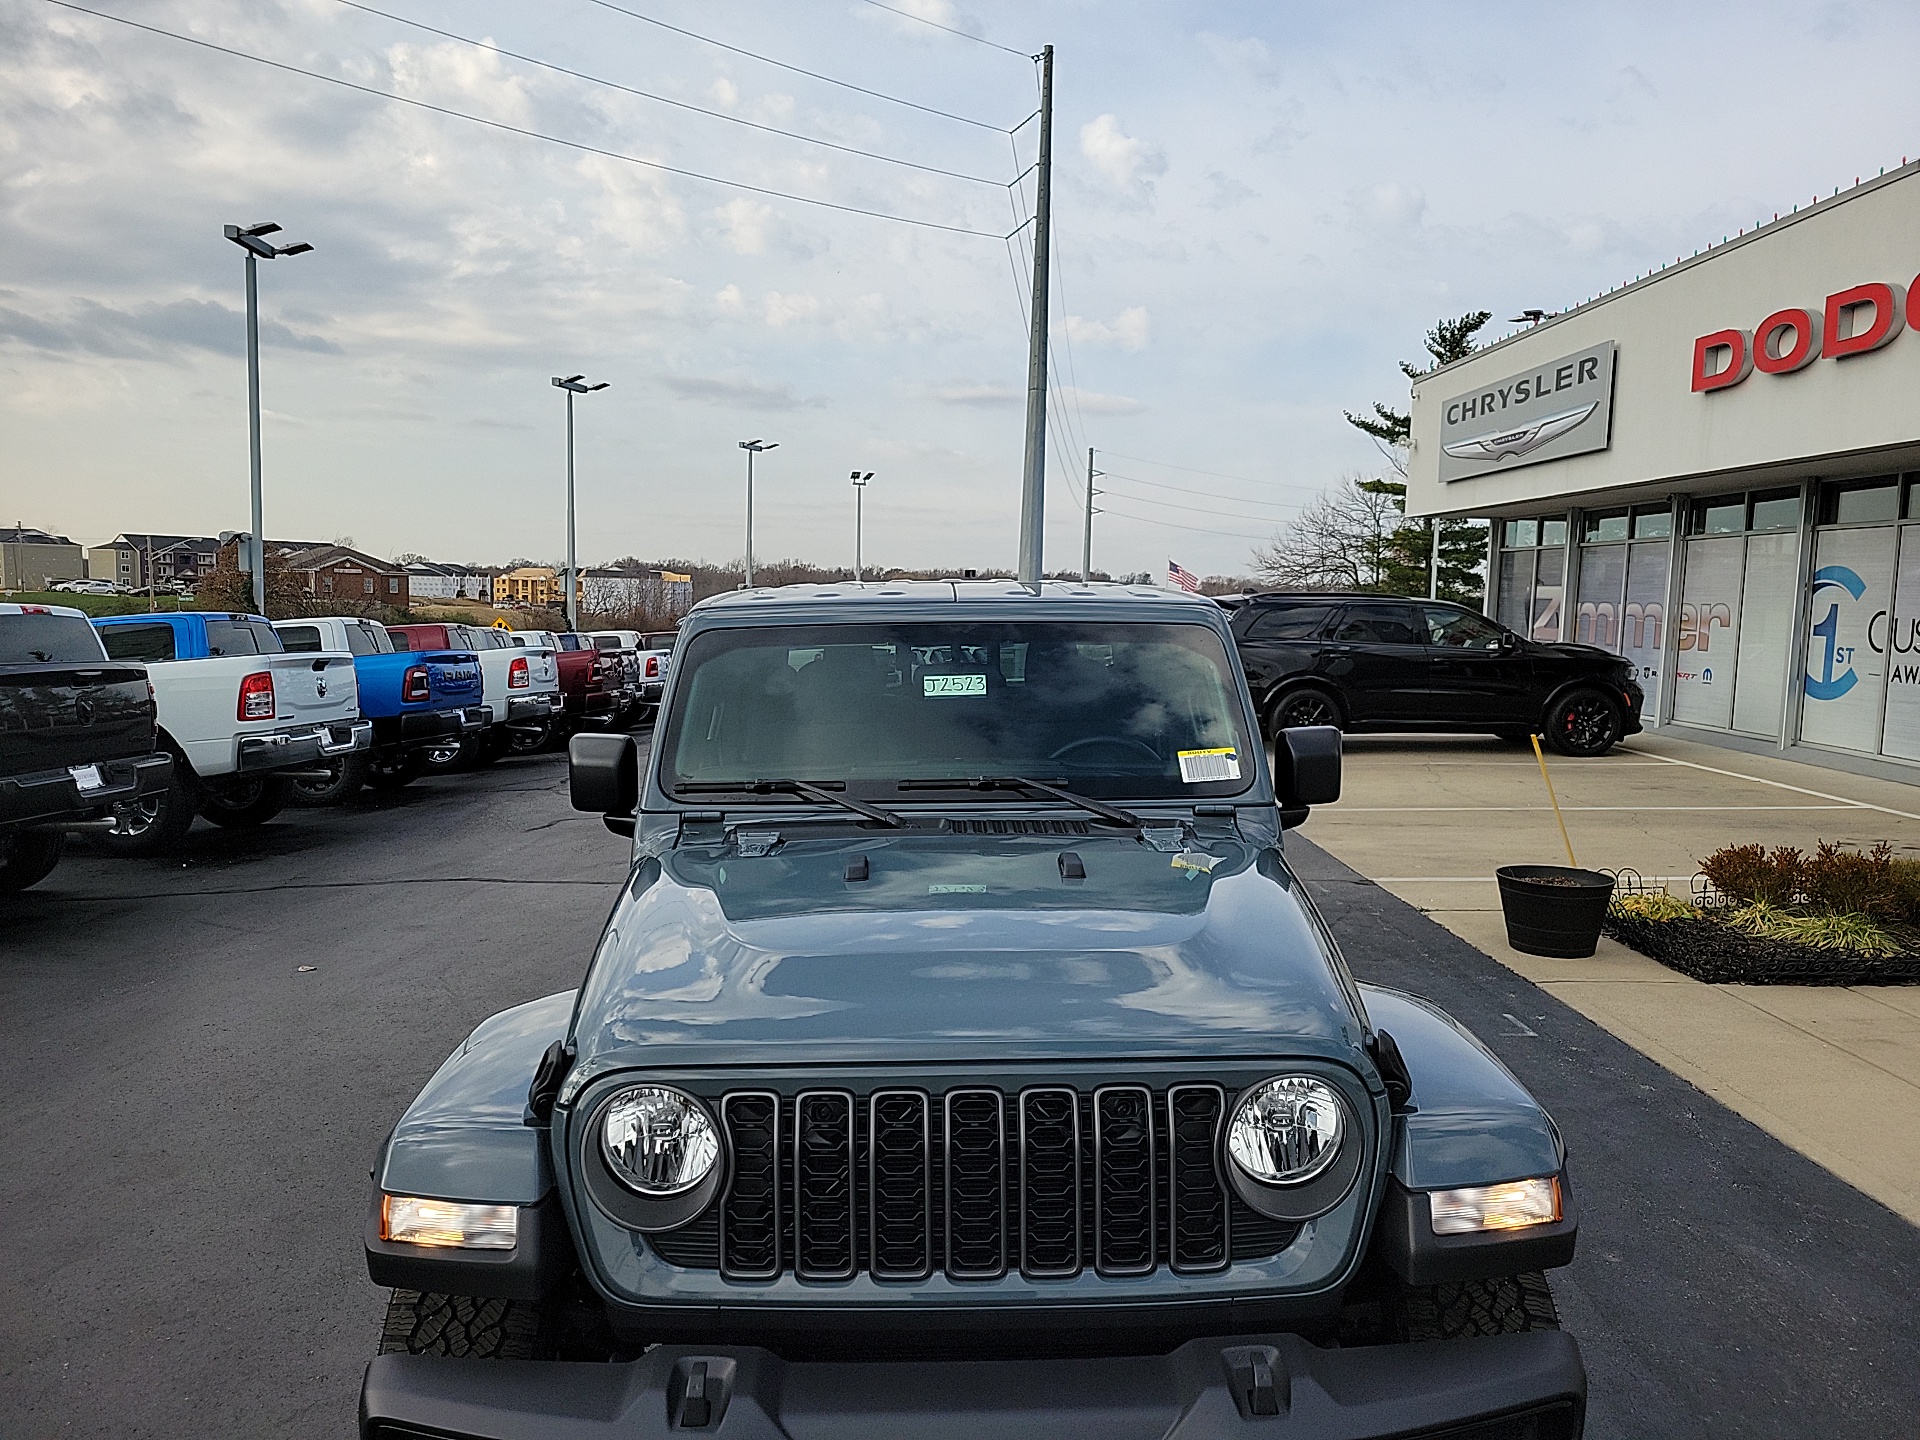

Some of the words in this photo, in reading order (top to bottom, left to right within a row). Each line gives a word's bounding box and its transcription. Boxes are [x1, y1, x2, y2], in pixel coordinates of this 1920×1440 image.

[1690, 271, 1920, 393] DOD
[1446, 356, 1598, 426] CHRYSLER
[1530, 585, 1731, 652] Zmmer
[443, 669, 474, 681] RAM
[924, 677, 986, 693] J2523
[1677, 672, 1698, 681] SRT
[1891, 664, 1920, 685] AW
